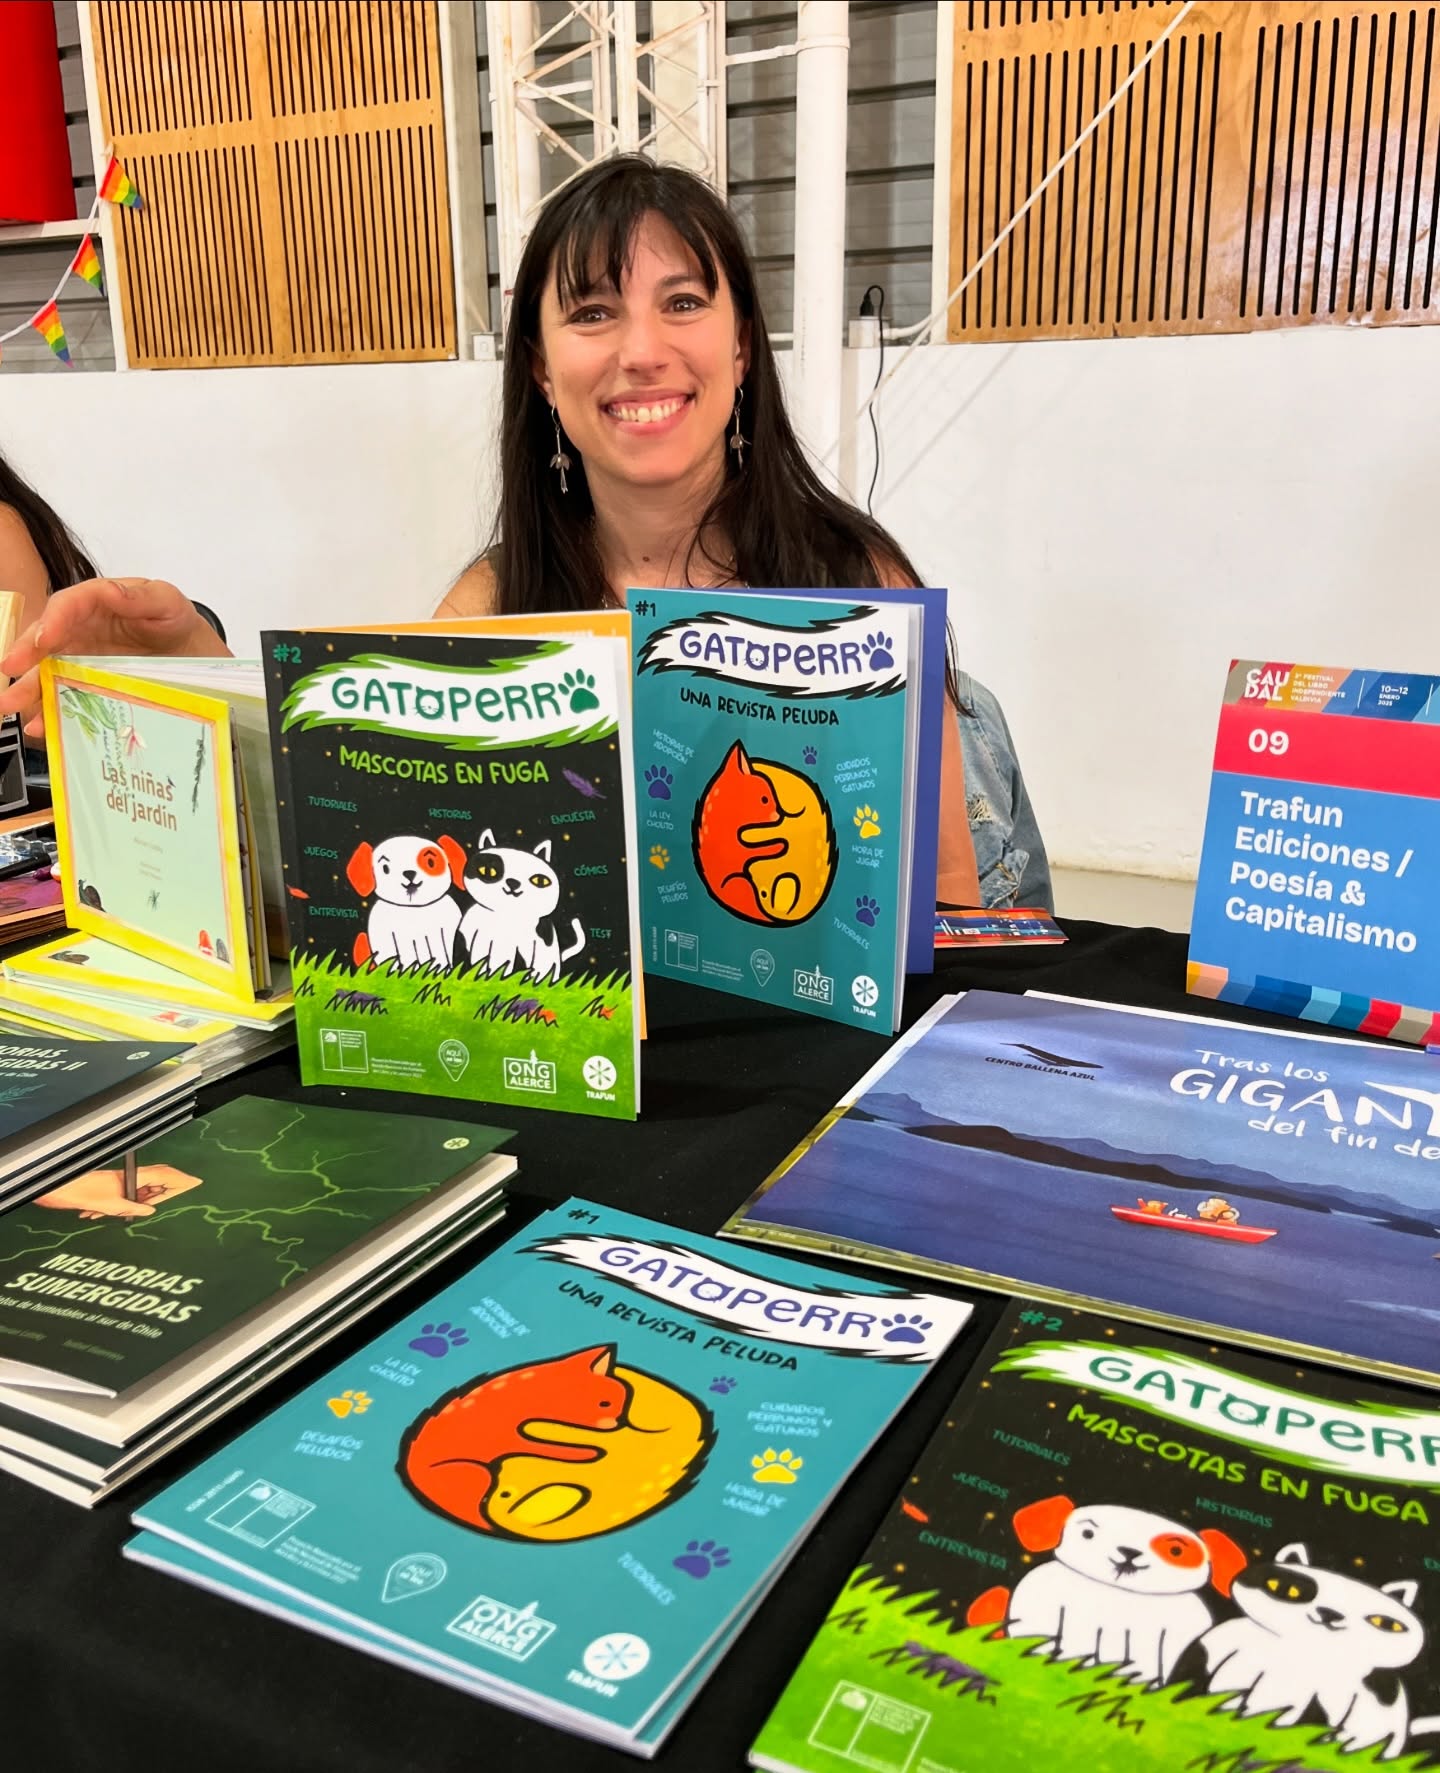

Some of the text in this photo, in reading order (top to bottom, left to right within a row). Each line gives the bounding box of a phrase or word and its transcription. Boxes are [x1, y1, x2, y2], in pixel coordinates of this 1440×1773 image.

[635, 601, 656, 617] #1
[273, 644, 302, 664] #2
[680, 686, 712, 709] UNA
[782, 705, 840, 726] PELUDA
[1248, 728, 1290, 755] 09
[339, 745, 550, 785] MASCOTAS EN FUGA
[101, 759, 173, 802] Las niñas
[106, 788, 129, 814] del
[308, 795, 358, 813] TUTORIALES
[427, 807, 472, 820] HISTORIAS
[1240, 790, 1343, 828] Trafun
[550, 809, 597, 826] ENCUESTA
[303, 846, 339, 860] JUEGOS
[1235, 826, 1390, 873] Ediciones
[1230, 861, 1366, 907] Poesía &
[309, 906, 359, 920] ENTREVISTA
[1225, 896, 1417, 953] Capitalismo
[590, 927, 613, 939] TEST
[797, 974, 830, 993] ONG
[797, 986, 830, 1001] ALERCE
[852, 1004, 877, 1018] TRAFUN
[0, 1045, 69, 1058] ORIAS
[508, 1060, 551, 1079] ONG
[984, 1056, 1095, 1081] CENTRO BALLENA AZUL
[1195, 1048, 1331, 1083] Tras los
[509, 1075, 551, 1090] ALERCE
[586, 1090, 616, 1101] TRAFUN
[1247, 1114, 1306, 1137] del
[1323, 1126, 1378, 1150] fin
[567, 1208, 601, 1225] #1
[39, 1253, 204, 1295] MEMORIAS
[4, 1271, 203, 1323] SUMERGIDAS
[558, 1279, 605, 1308] UNA
[703, 1335, 798, 1371] PELUDA
[1019, 1310, 1063, 1332] #2
[992, 1428, 1071, 1467] TUTORIALES
[1067, 1404, 1430, 1525] MASCOTAS EN FUGA
[952, 1471, 1010, 1500] JUEGOS
[1195, 1496, 1274, 1528] HISTORIAS
[918, 1529, 1008, 1571] ENTREVISTA
[472, 1602, 542, 1641] ONG
[458, 1619, 529, 1653] ALERCE
